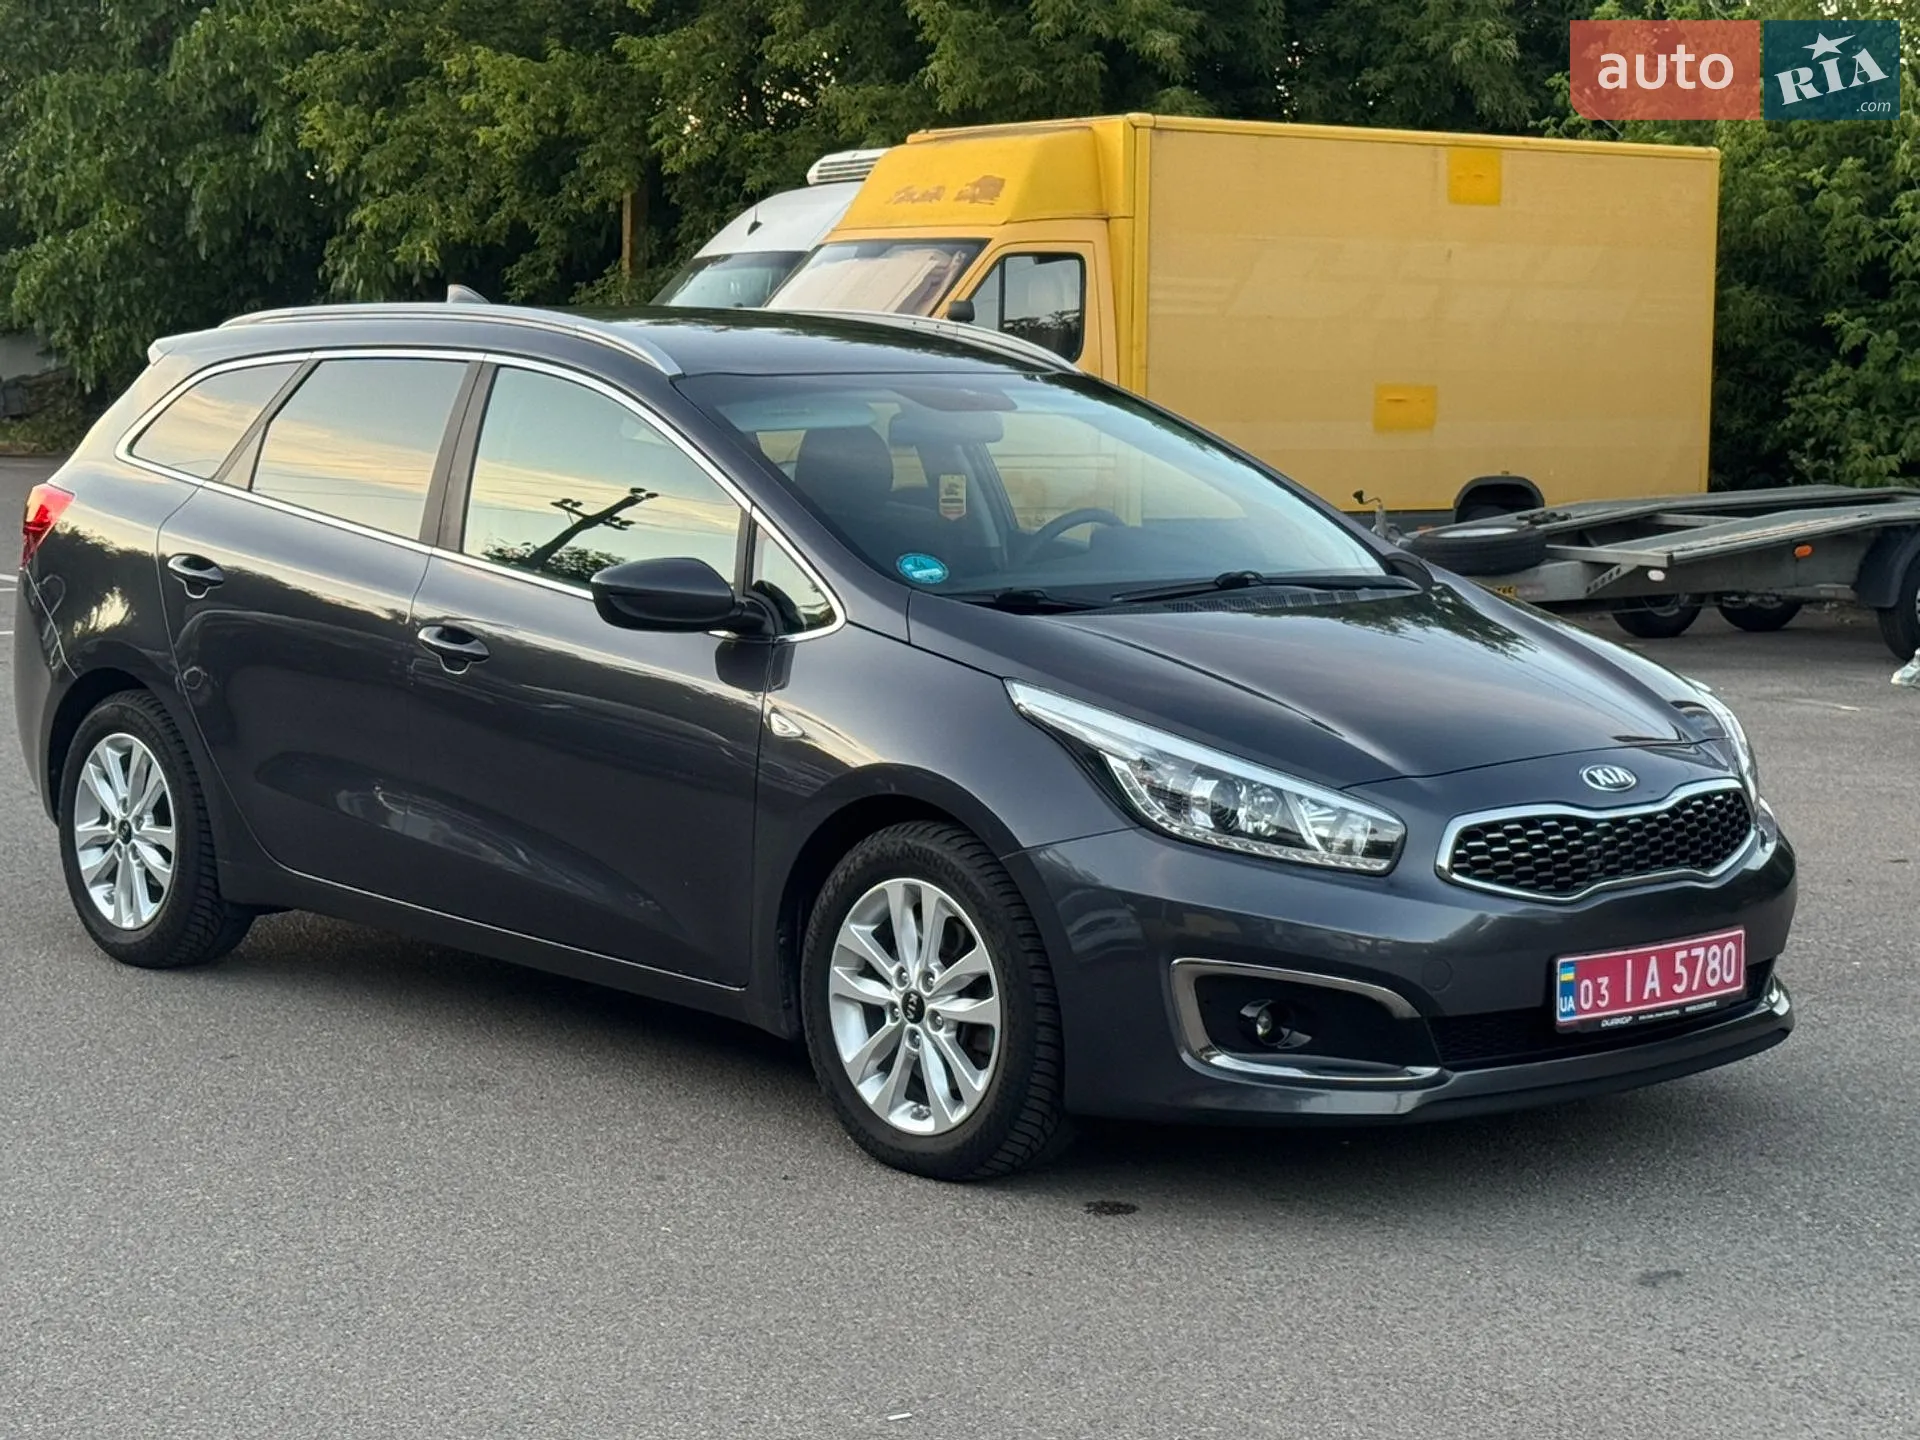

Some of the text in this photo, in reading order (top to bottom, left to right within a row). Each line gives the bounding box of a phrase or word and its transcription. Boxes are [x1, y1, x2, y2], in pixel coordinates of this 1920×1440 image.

[1589, 767, 1633, 786] KIA
[1580, 941, 1736, 1011] 03 IA 5780
[1560, 996, 1576, 1013] UA
